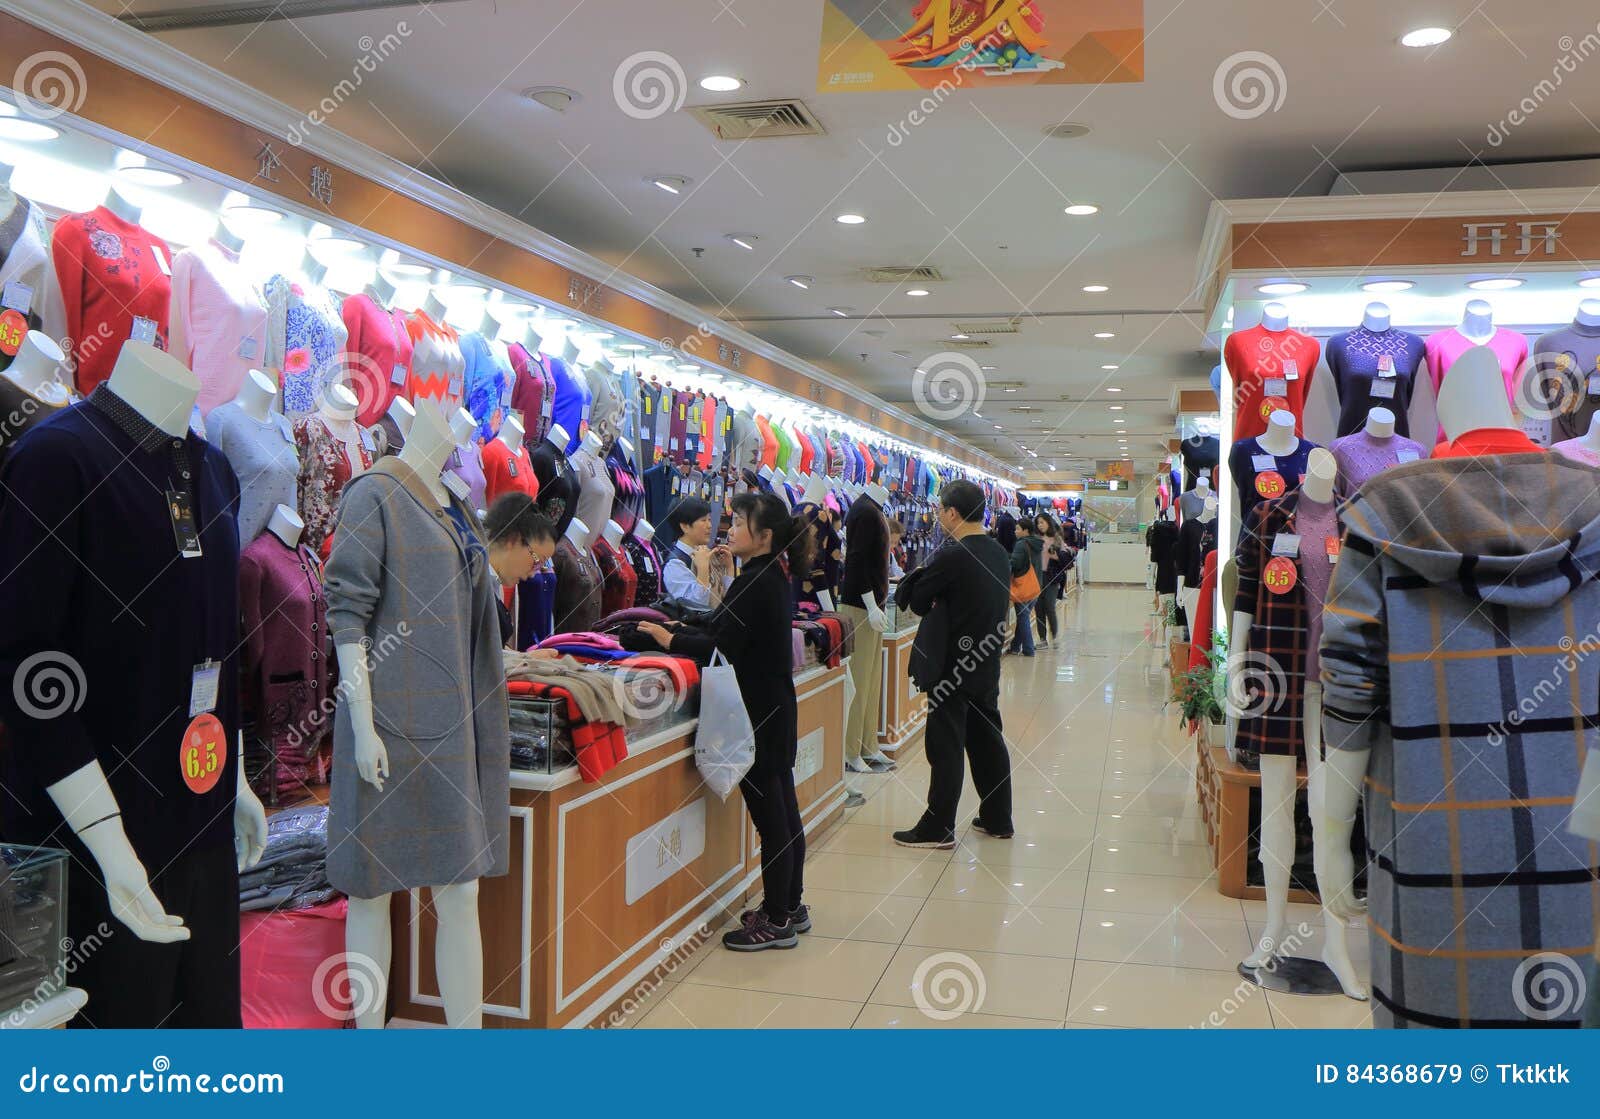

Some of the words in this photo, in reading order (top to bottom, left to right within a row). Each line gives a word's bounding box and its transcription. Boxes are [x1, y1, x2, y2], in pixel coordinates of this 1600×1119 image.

[1257, 481, 1279, 494] 6.5
[1266, 570, 1289, 587] 6.5
[186, 742, 218, 779] 6.5
